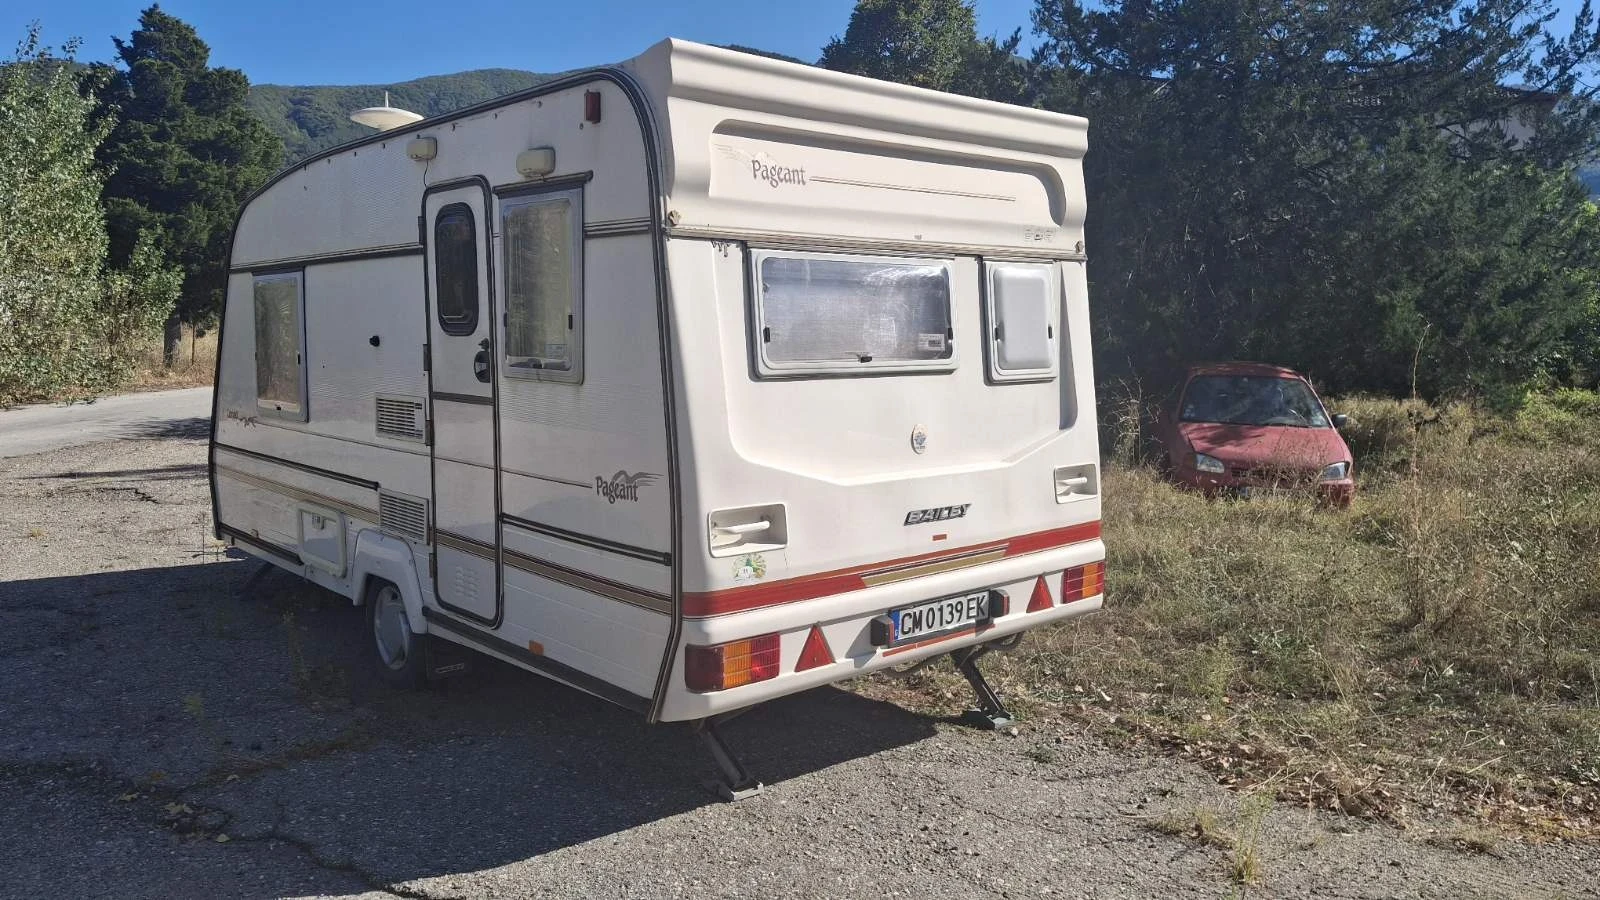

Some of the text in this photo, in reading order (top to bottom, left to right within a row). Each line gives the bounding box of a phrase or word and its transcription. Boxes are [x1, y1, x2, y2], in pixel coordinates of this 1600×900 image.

[752, 160, 806, 188] Pageant
[595, 476, 638, 504] Pageant
[904, 503, 971, 526] BAILEY
[901, 595, 986, 635] CM 0139 EK
